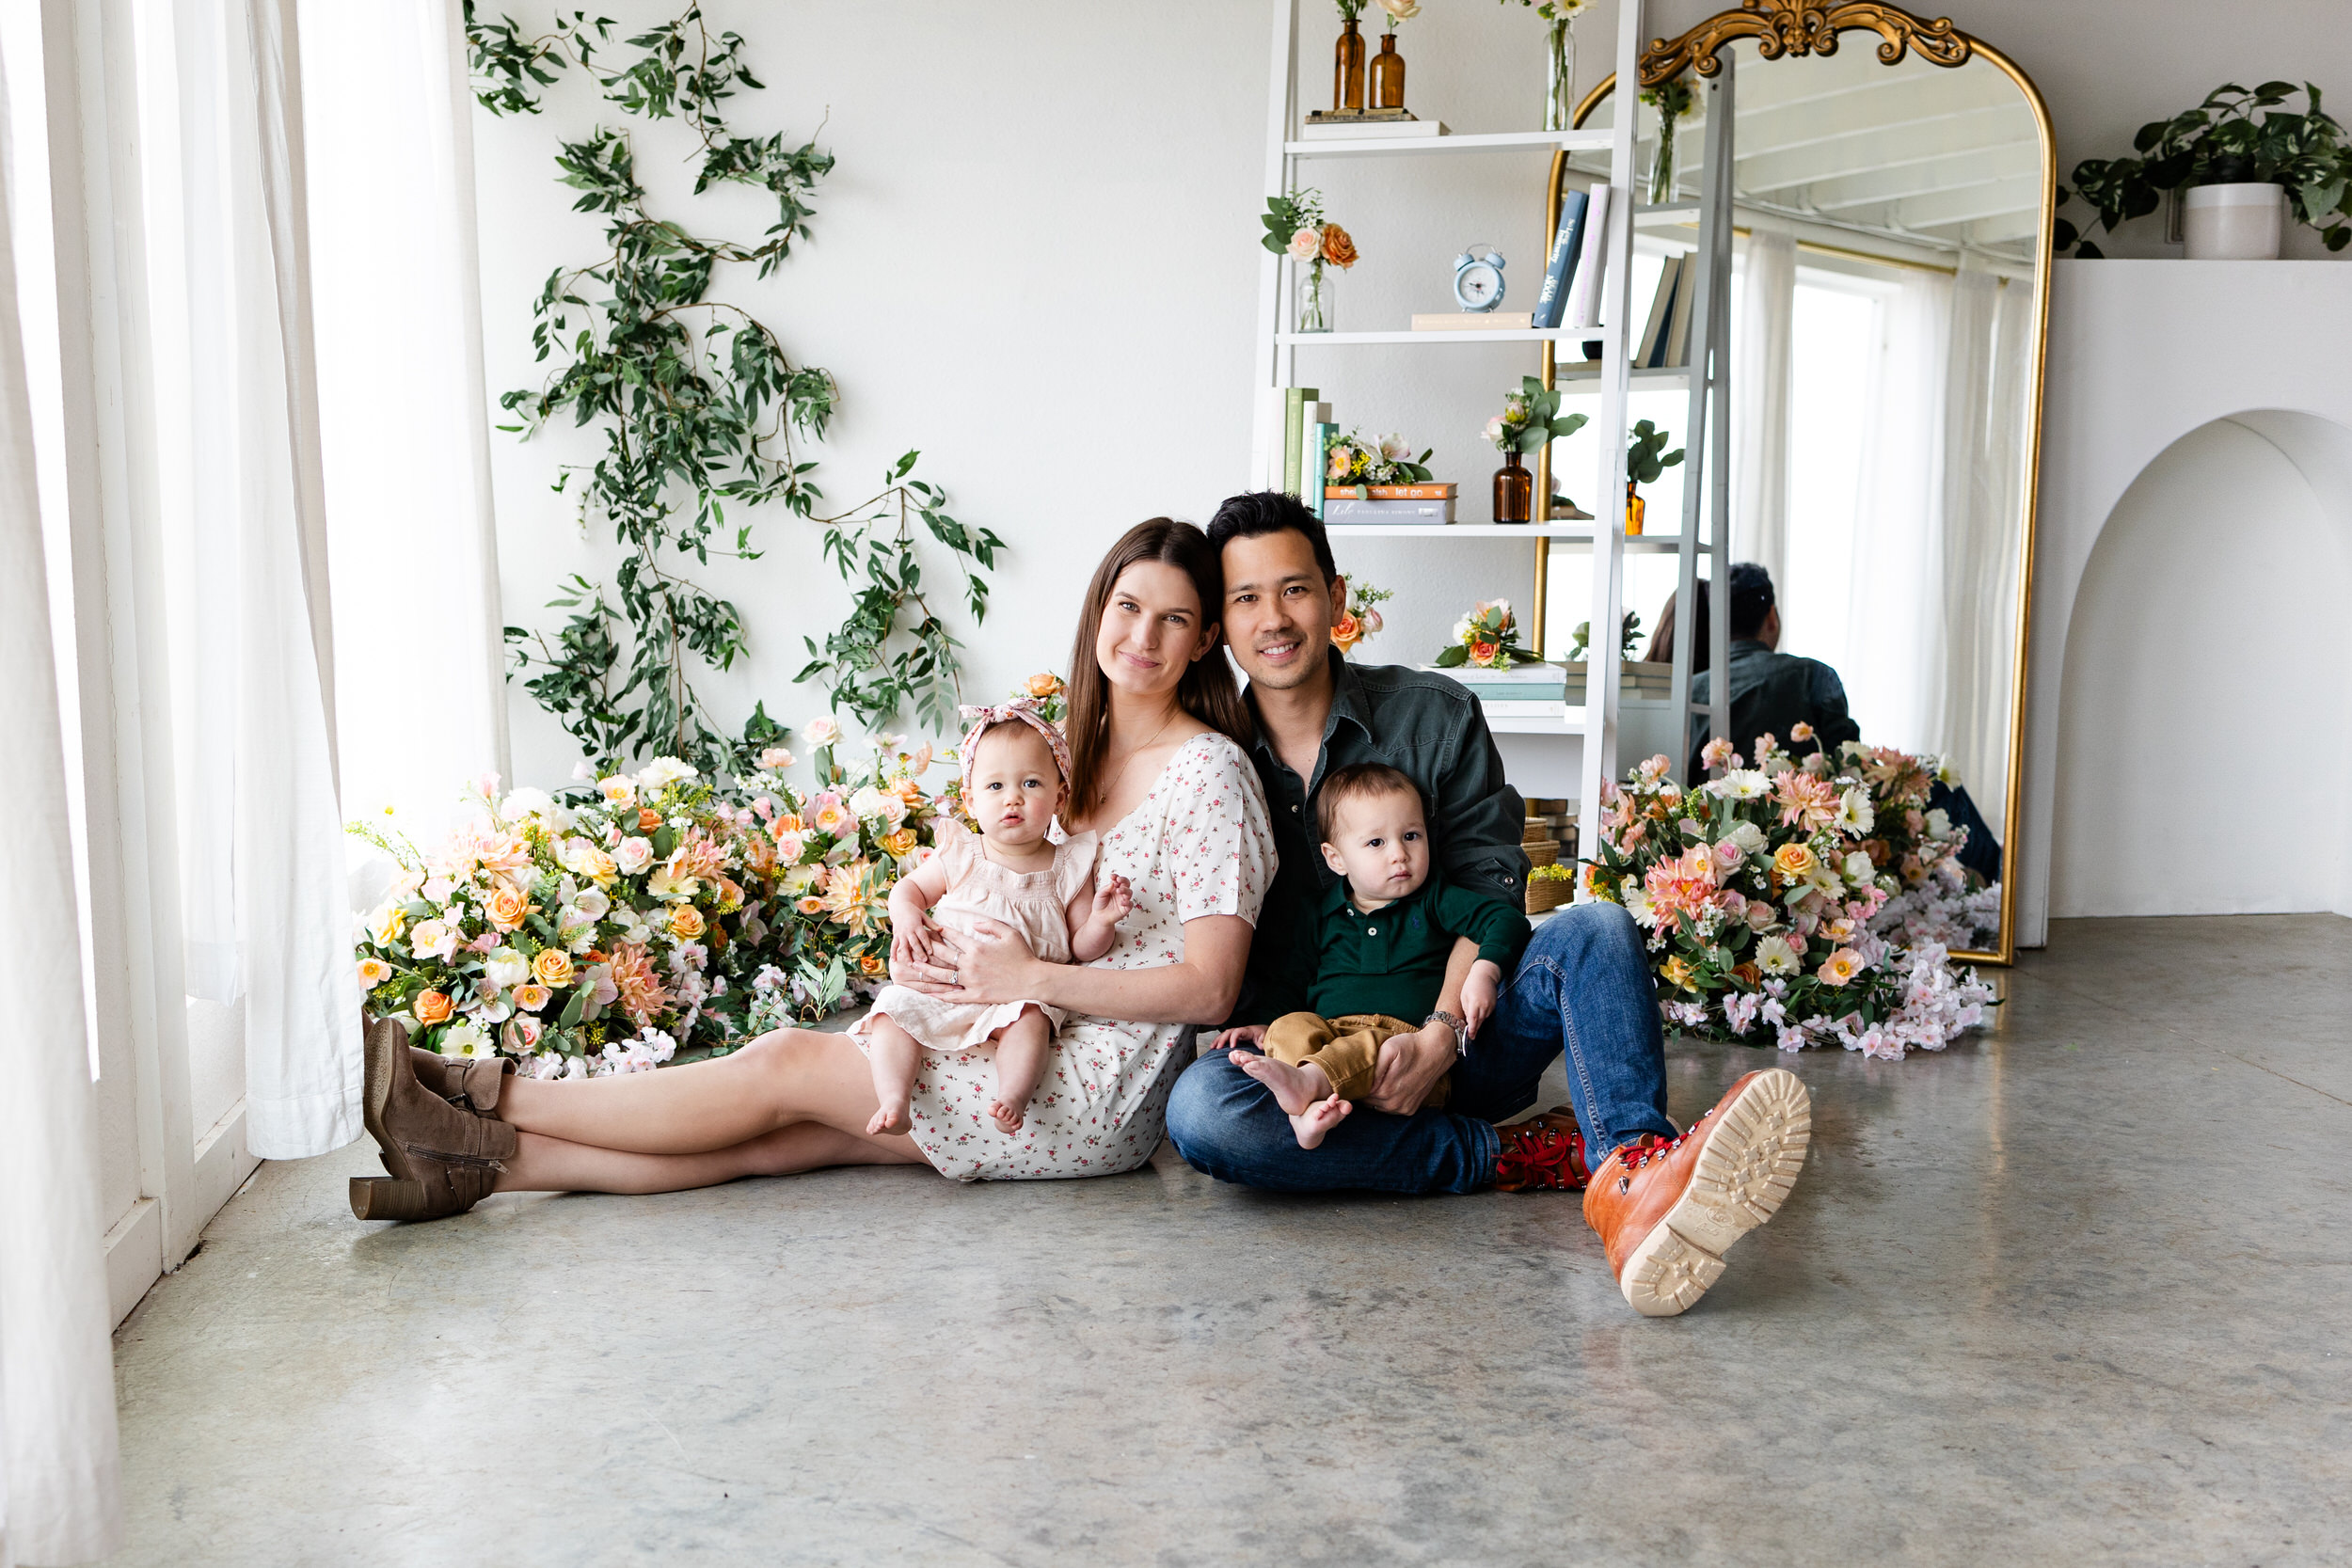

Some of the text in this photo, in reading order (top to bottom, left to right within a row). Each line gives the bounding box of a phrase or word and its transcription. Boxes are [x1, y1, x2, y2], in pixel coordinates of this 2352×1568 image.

[1550, 230, 1565, 263] Insecurity
[1395, 487, 1407, 497] let
[1410, 489, 1423, 499] go
